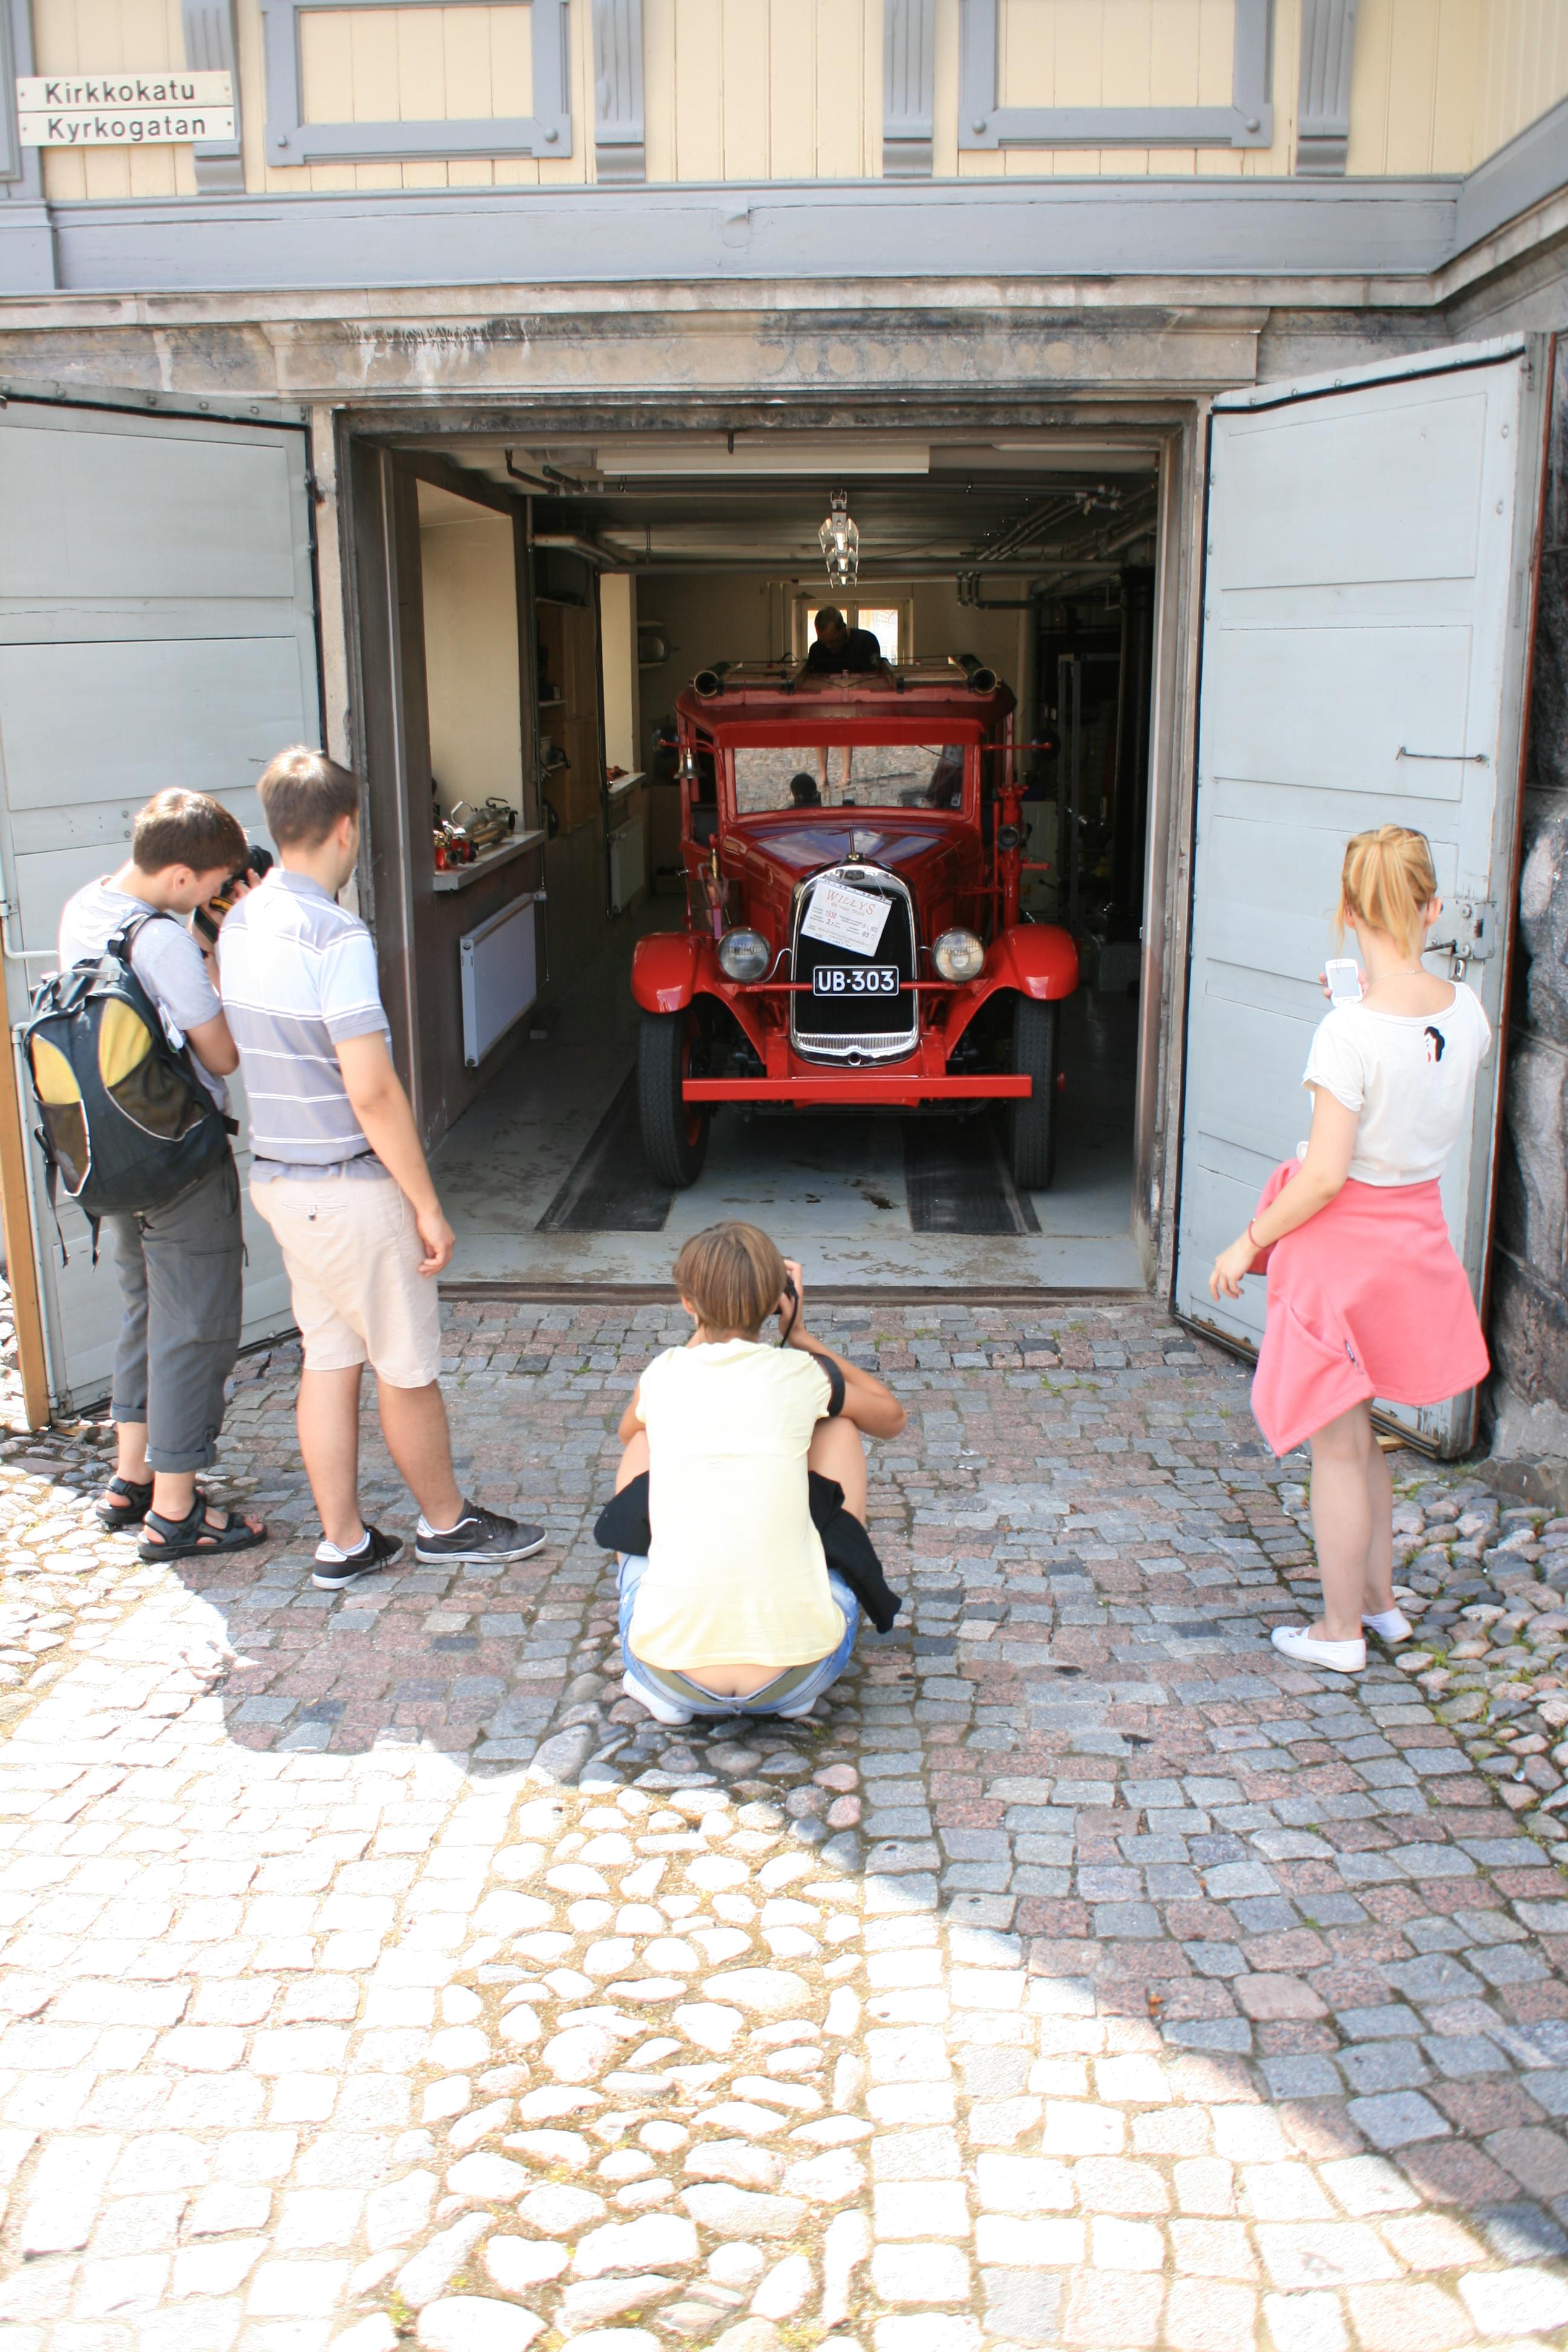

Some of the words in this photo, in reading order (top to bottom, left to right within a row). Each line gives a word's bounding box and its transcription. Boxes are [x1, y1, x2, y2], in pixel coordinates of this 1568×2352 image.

[45, 79, 195, 105] Kirkkokatu
[48, 116, 206, 143] Kyrkogatan
[825, 909, 837, 919] 1930
[826, 889, 876, 915] WILLYS
